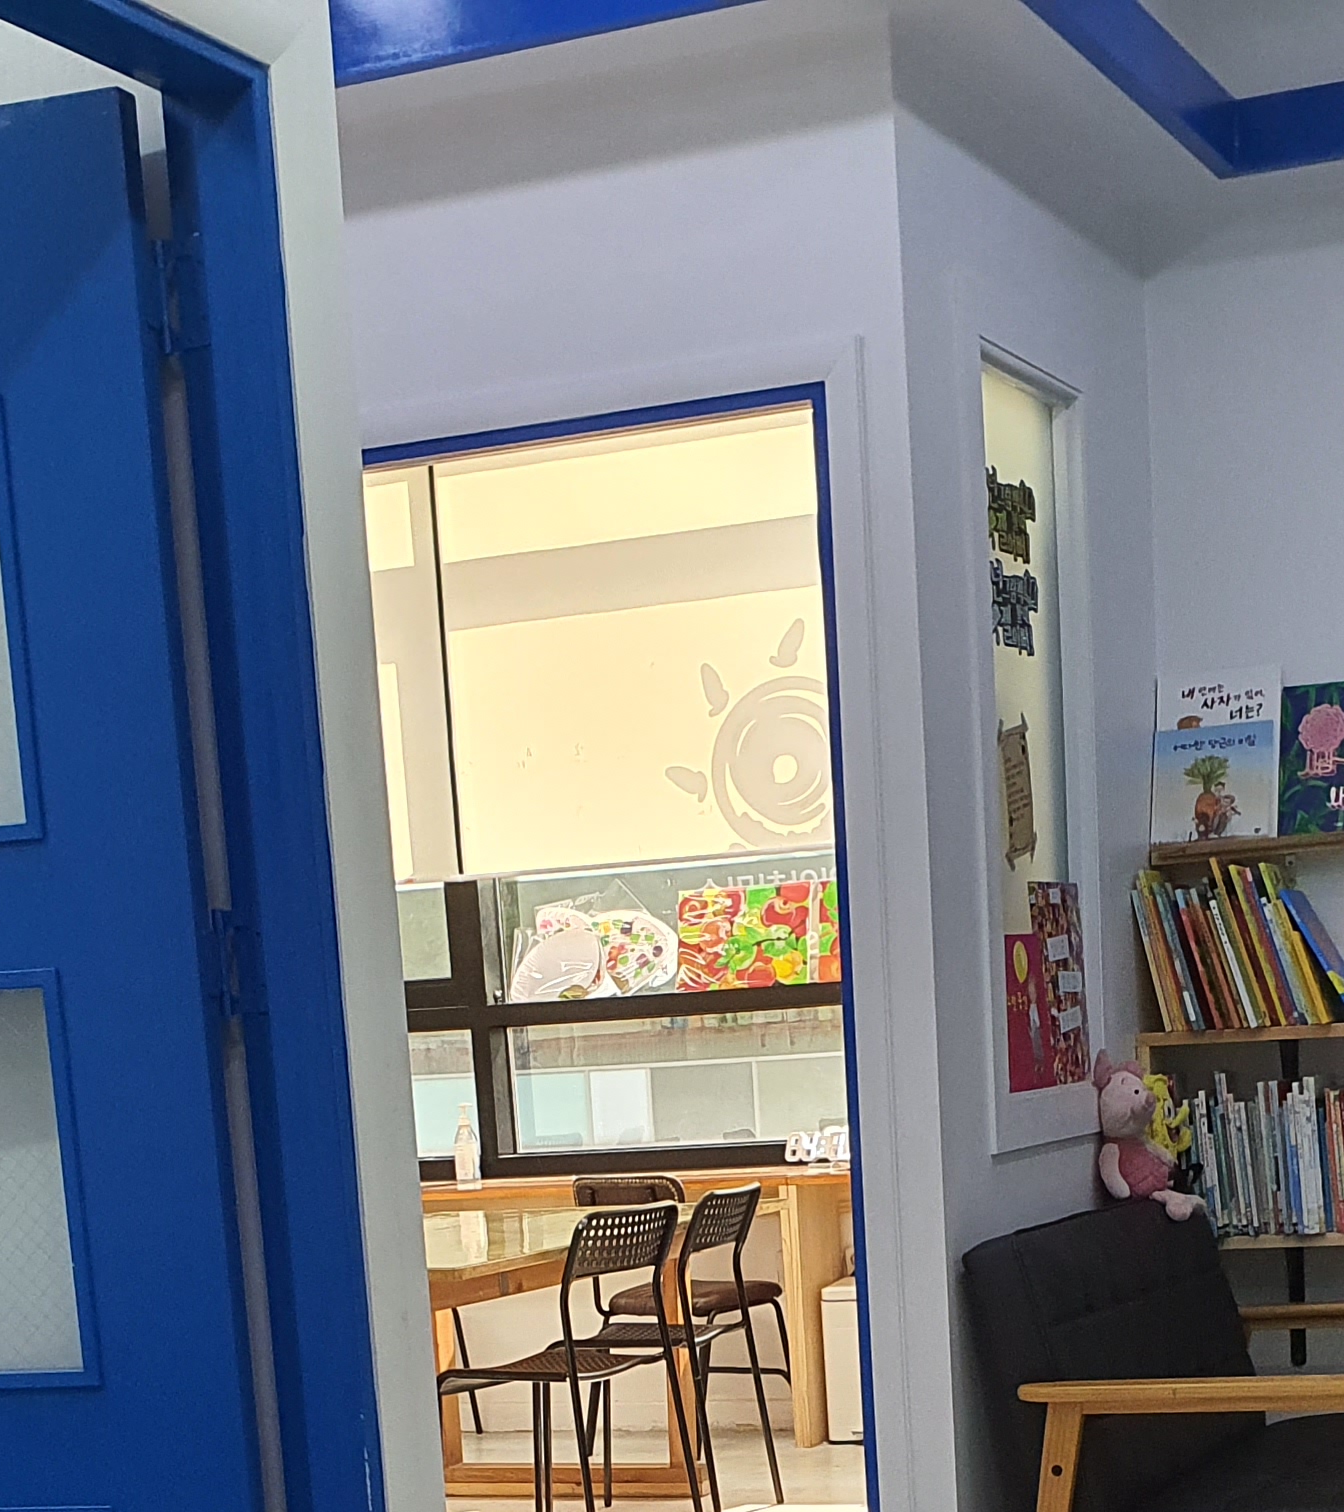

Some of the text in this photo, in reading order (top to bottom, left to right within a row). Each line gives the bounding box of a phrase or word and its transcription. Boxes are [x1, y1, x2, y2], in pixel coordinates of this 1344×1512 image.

[1181, 687, 1195, 700] 내
[1201, 693, 1241, 710] 사자가
[1229, 702, 1263, 720] 너는?
